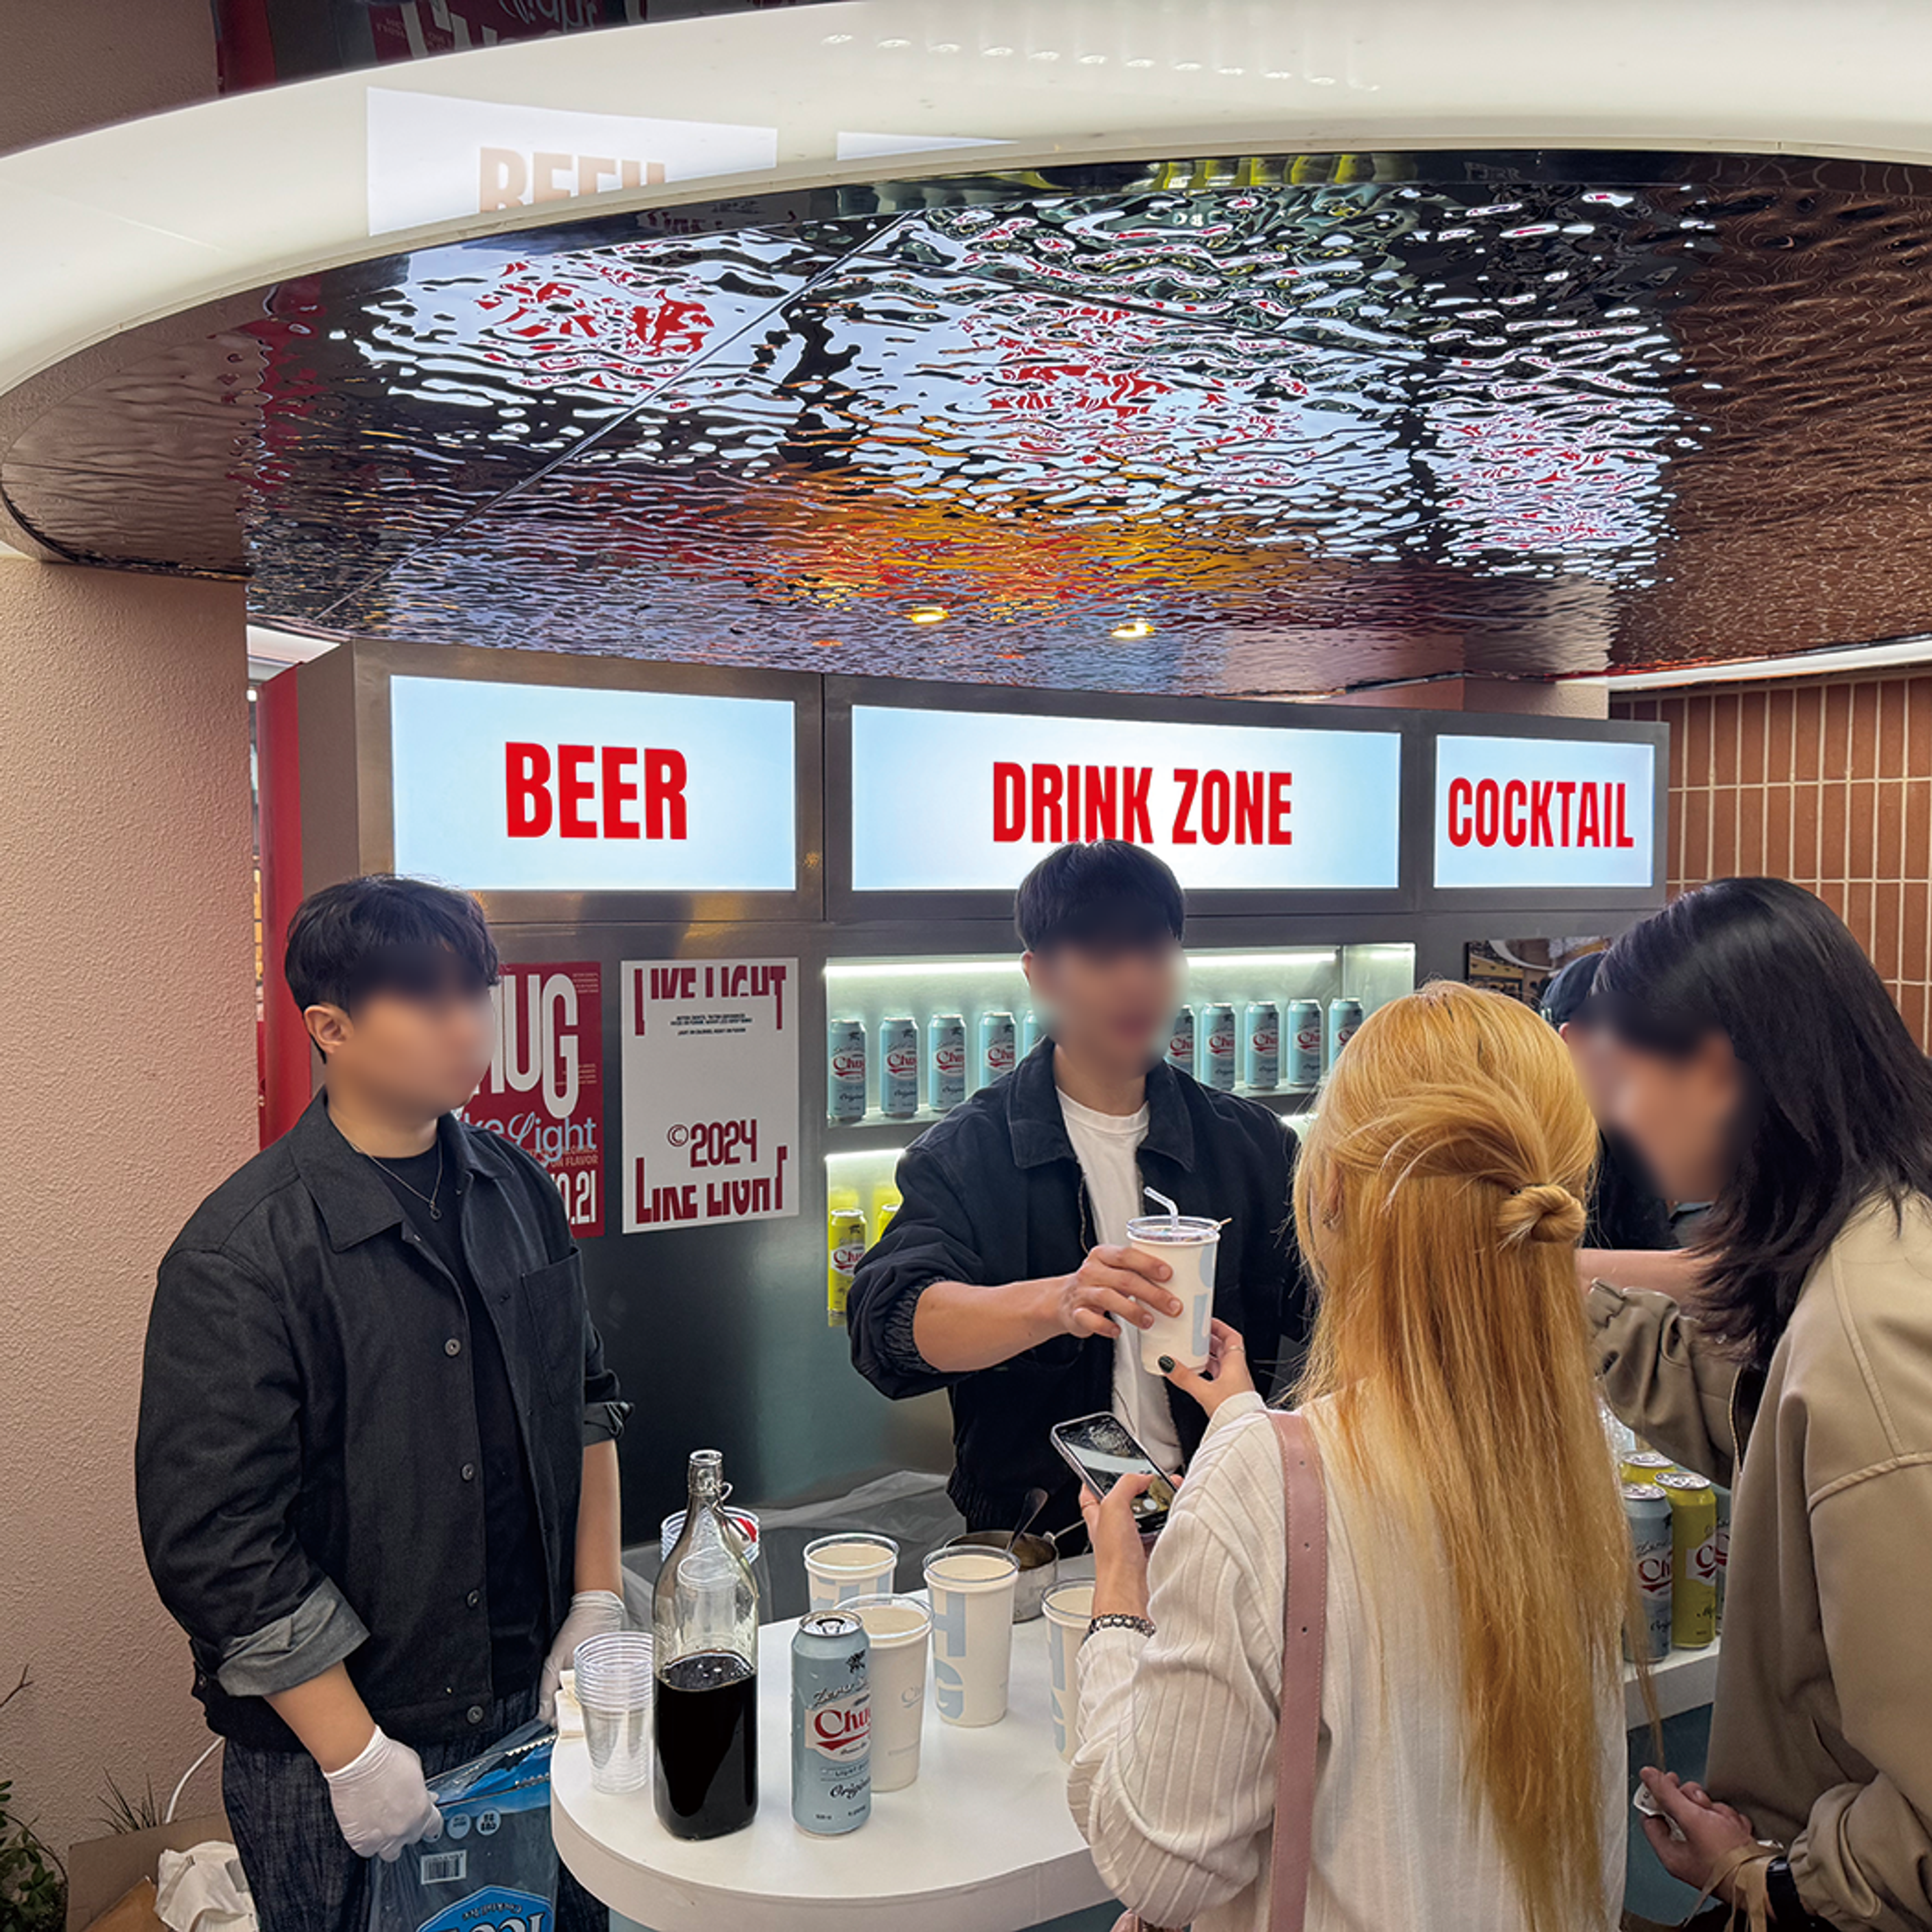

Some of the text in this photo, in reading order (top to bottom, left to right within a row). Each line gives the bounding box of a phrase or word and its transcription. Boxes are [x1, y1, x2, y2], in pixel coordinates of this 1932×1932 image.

[505, 742, 687, 840] BEER
[993, 761, 1293, 845] DRINK ZONE
[1448, 777, 1634, 848] COCKTAIL
[508, 1111, 597, 1167] Light
[551, 1170, 596, 1225] 0.21
